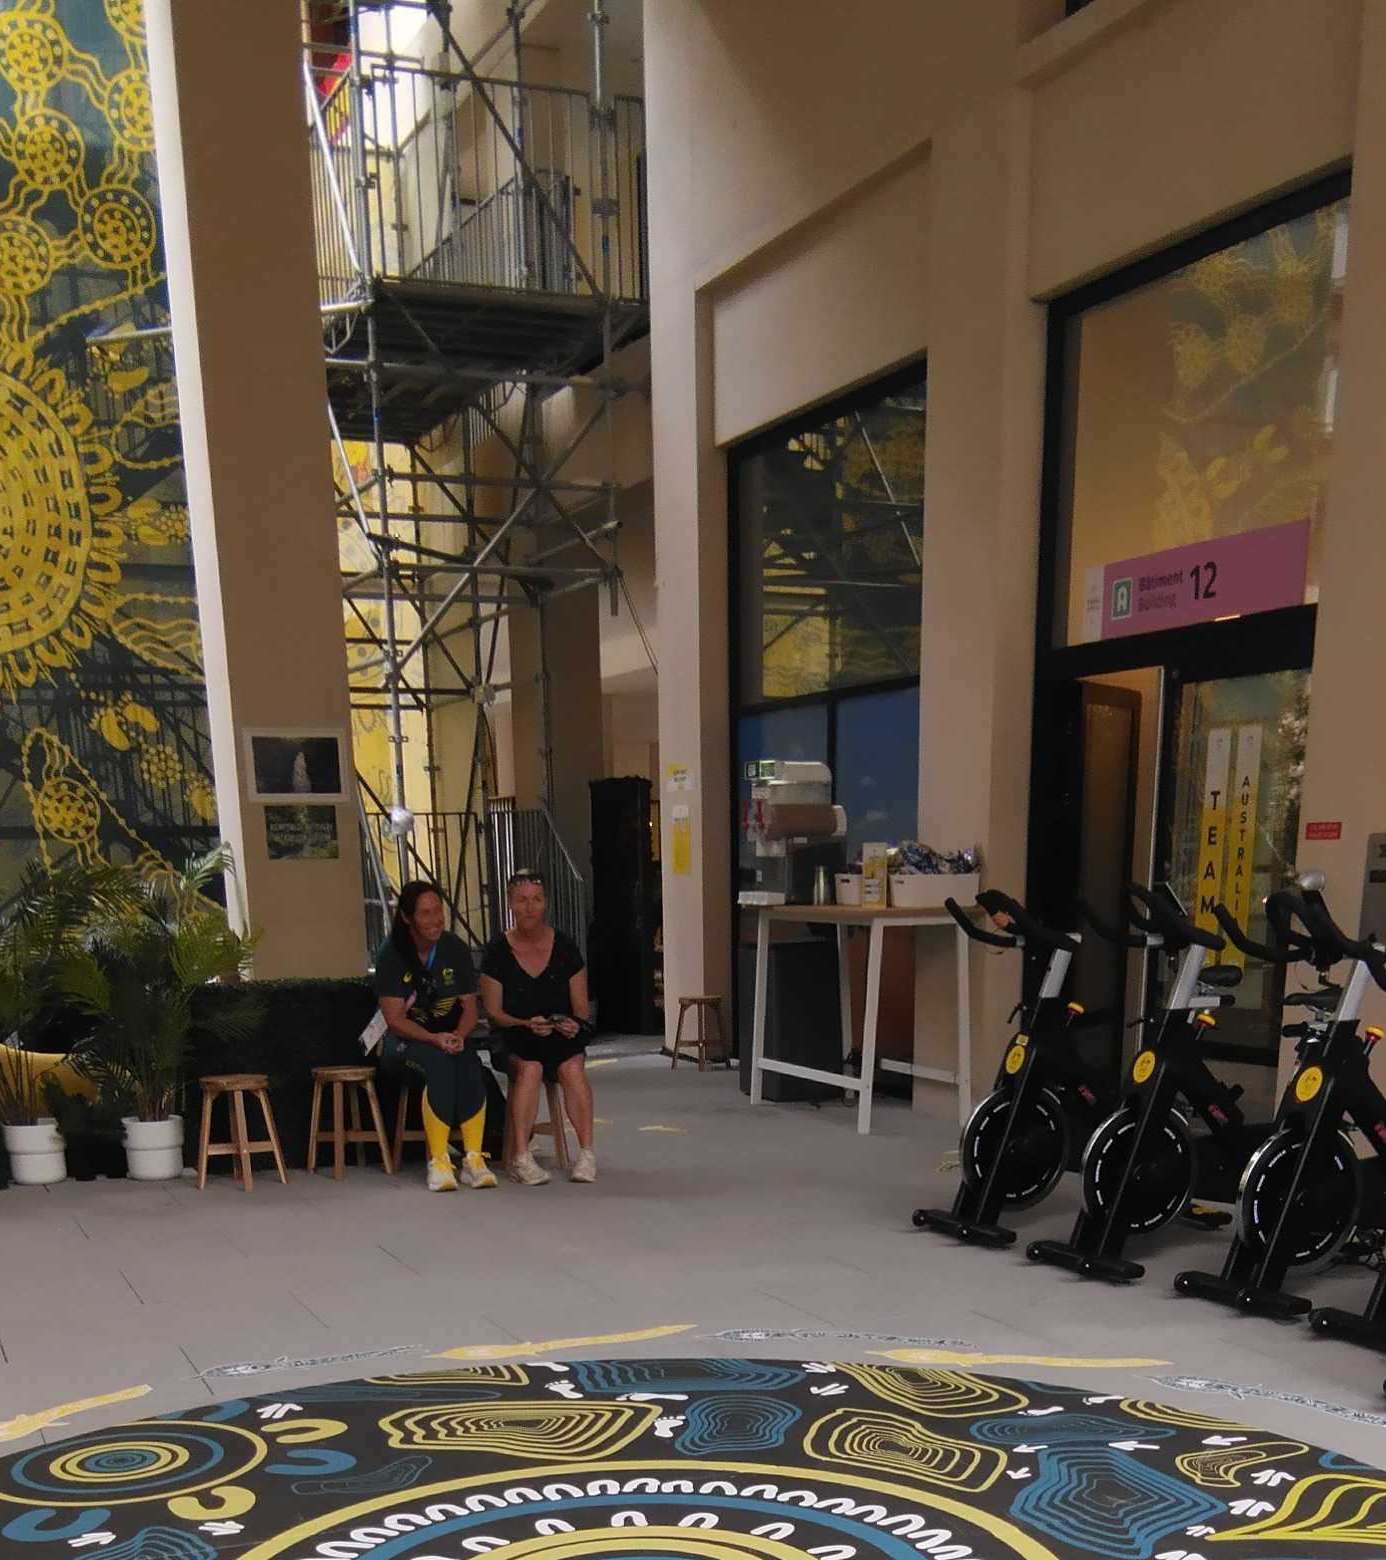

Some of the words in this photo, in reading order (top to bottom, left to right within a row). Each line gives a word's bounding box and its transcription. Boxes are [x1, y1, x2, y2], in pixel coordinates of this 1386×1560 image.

[1138, 571, 1184, 592] Bâtiment
[1189, 561, 1218, 600] 12
[1200, 790, 1221, 914] TEAM
[1233, 775, 1251, 920] AUSTRALI
